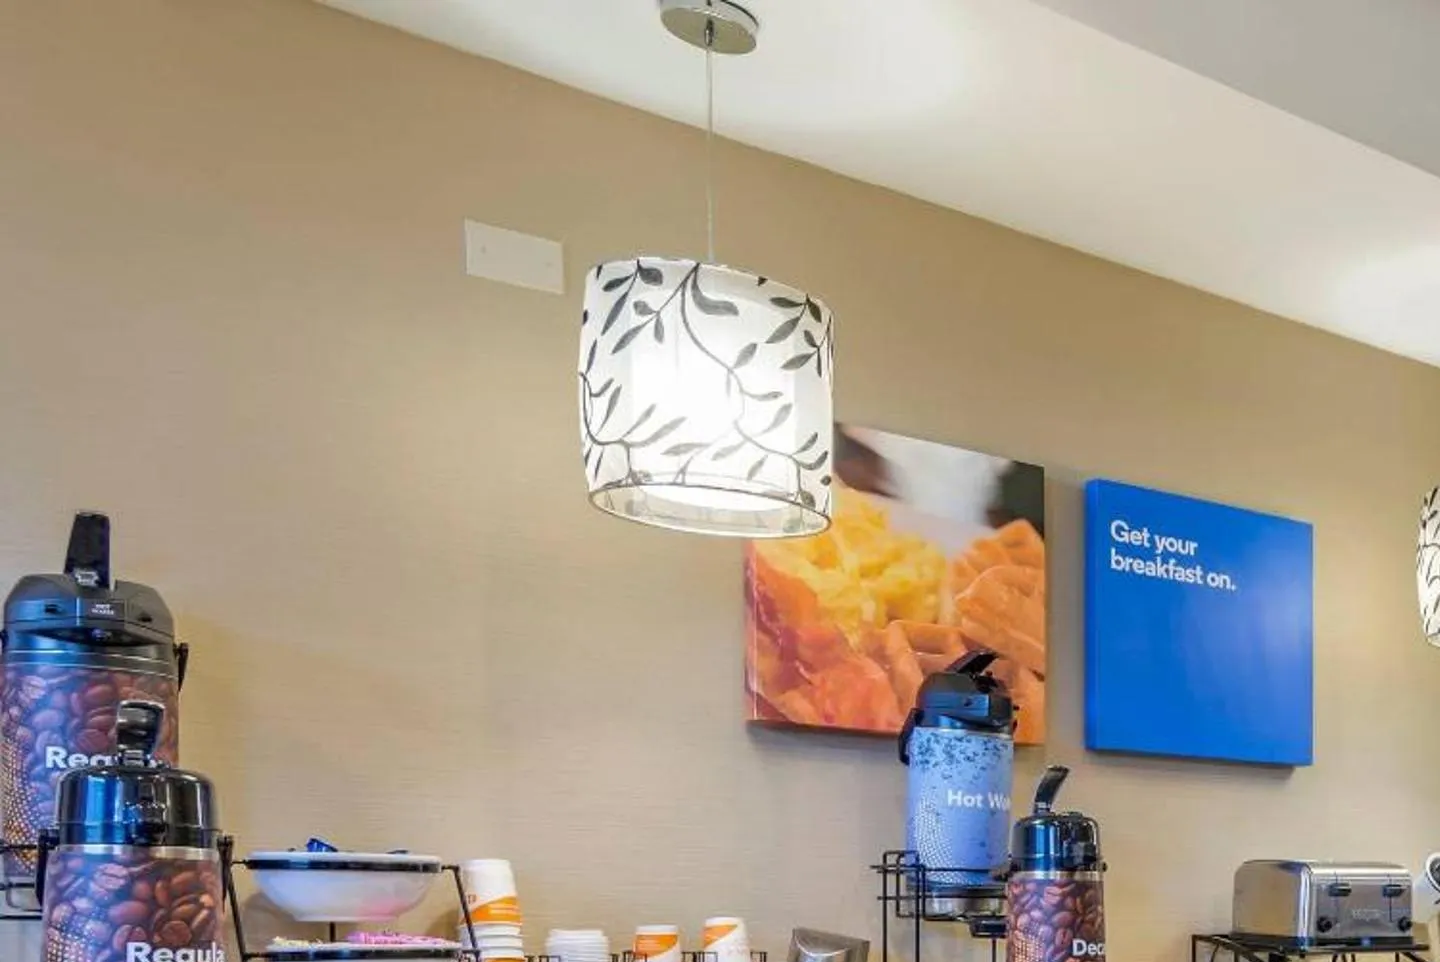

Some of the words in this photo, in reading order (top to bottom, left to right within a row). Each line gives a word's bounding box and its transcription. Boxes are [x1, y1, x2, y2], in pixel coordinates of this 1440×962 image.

[1110, 519, 1151, 548] Get
[1154, 533, 1198, 556] your
[1110, 547, 1204, 585] breakfast
[1206, 571, 1237, 591] on.
[947, 789, 983, 808] Hot
